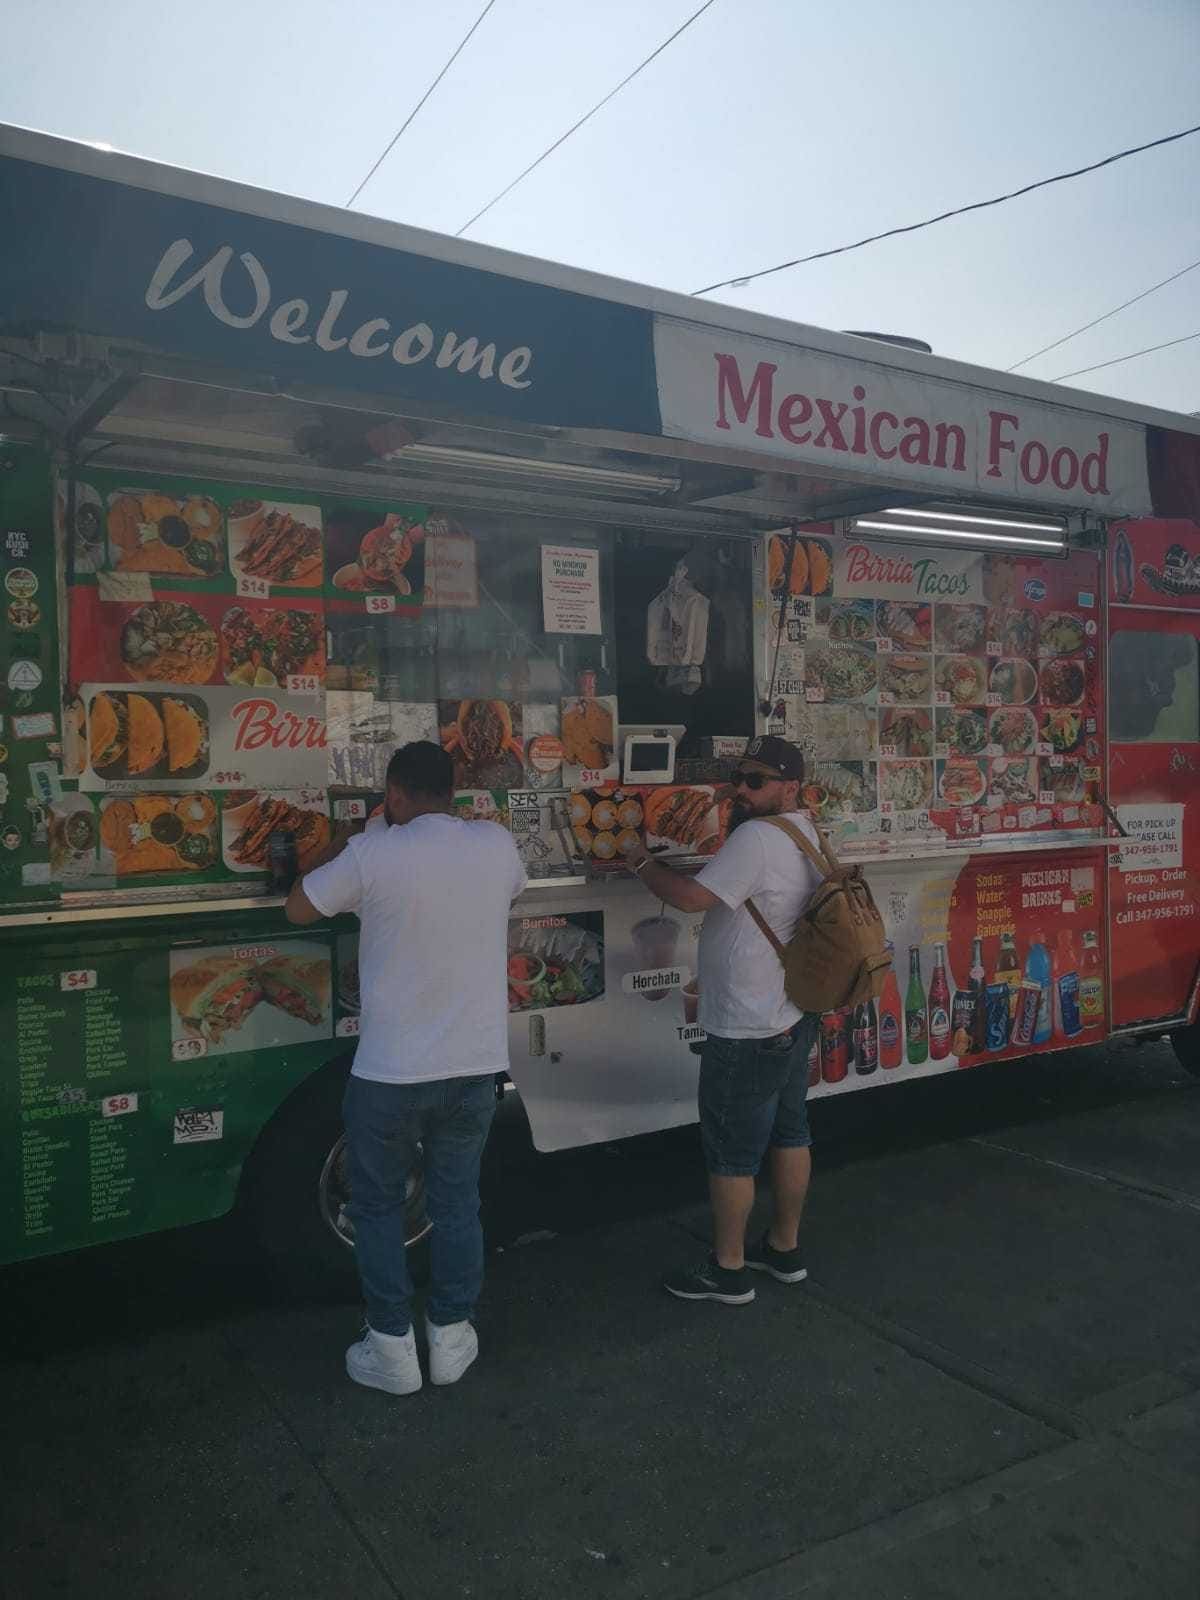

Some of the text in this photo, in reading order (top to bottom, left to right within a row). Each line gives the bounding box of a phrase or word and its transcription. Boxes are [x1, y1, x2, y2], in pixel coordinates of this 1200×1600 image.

[145, 238, 532, 389] Welcome
[713, 352, 1111, 495] Mexican Food
[847, 544, 969, 596] Birria Tacos
[241, 579, 266, 594] $14
[371, 598, 389, 610] $8
[291, 678, 316, 690] $14
[216, 771, 242, 783] $14
[1128, 818, 1176, 830] FOR PICK UP
[1158, 831, 1176, 840] CALL
[1125, 844, 1178, 856] 347-956-1791
[1022, 869, 1069, 887] MEXICAN
[1162, 870, 1187, 881] Order
[1022, 891, 1062, 908] DRINKS
[1127, 887, 1184, 904] Free Delivery
[976, 905, 1013, 921] Snapple
[1116, 904, 1194, 924] Call 347-956-1791
[522, 916, 568, 930] Burritos
[976, 922, 1017, 938] Gatorade
[232, 946, 275, 960] Tortas
[68, 972, 89, 987] $4
[633, 971, 681, 989] Horchata
[108, 1097, 130, 1114] $8
